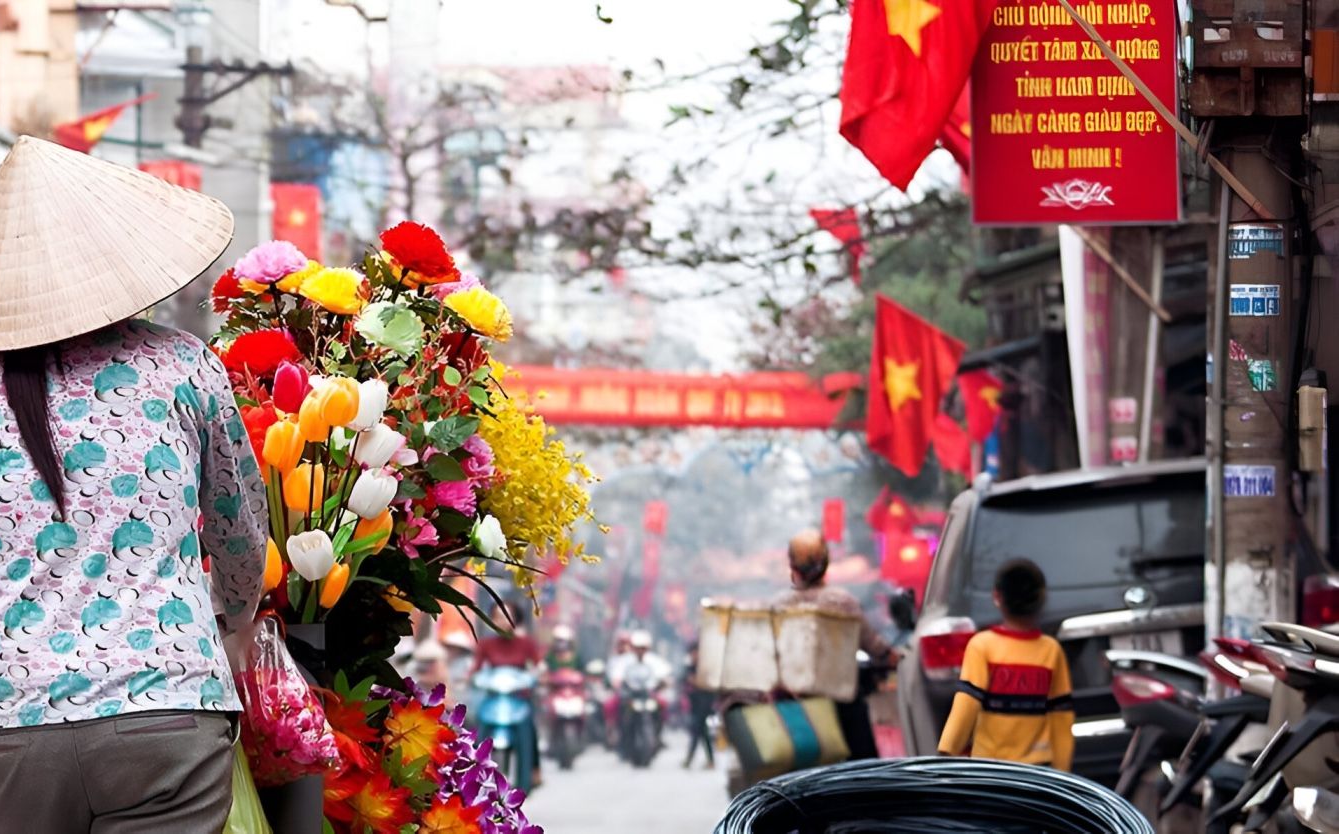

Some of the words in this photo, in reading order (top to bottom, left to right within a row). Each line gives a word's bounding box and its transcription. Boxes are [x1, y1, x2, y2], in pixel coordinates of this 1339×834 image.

[991, 35, 1039, 63] QUYẾT
[1042, 38, 1077, 61] TÂM
[1056, 77, 1093, 96] NAM
[990, 109, 1033, 134] NGÀY
[1037, 109, 1081, 133] CÀNG
[1085, 108, 1122, 132] GIÀU
[1068, 148, 1111, 168] MINH
